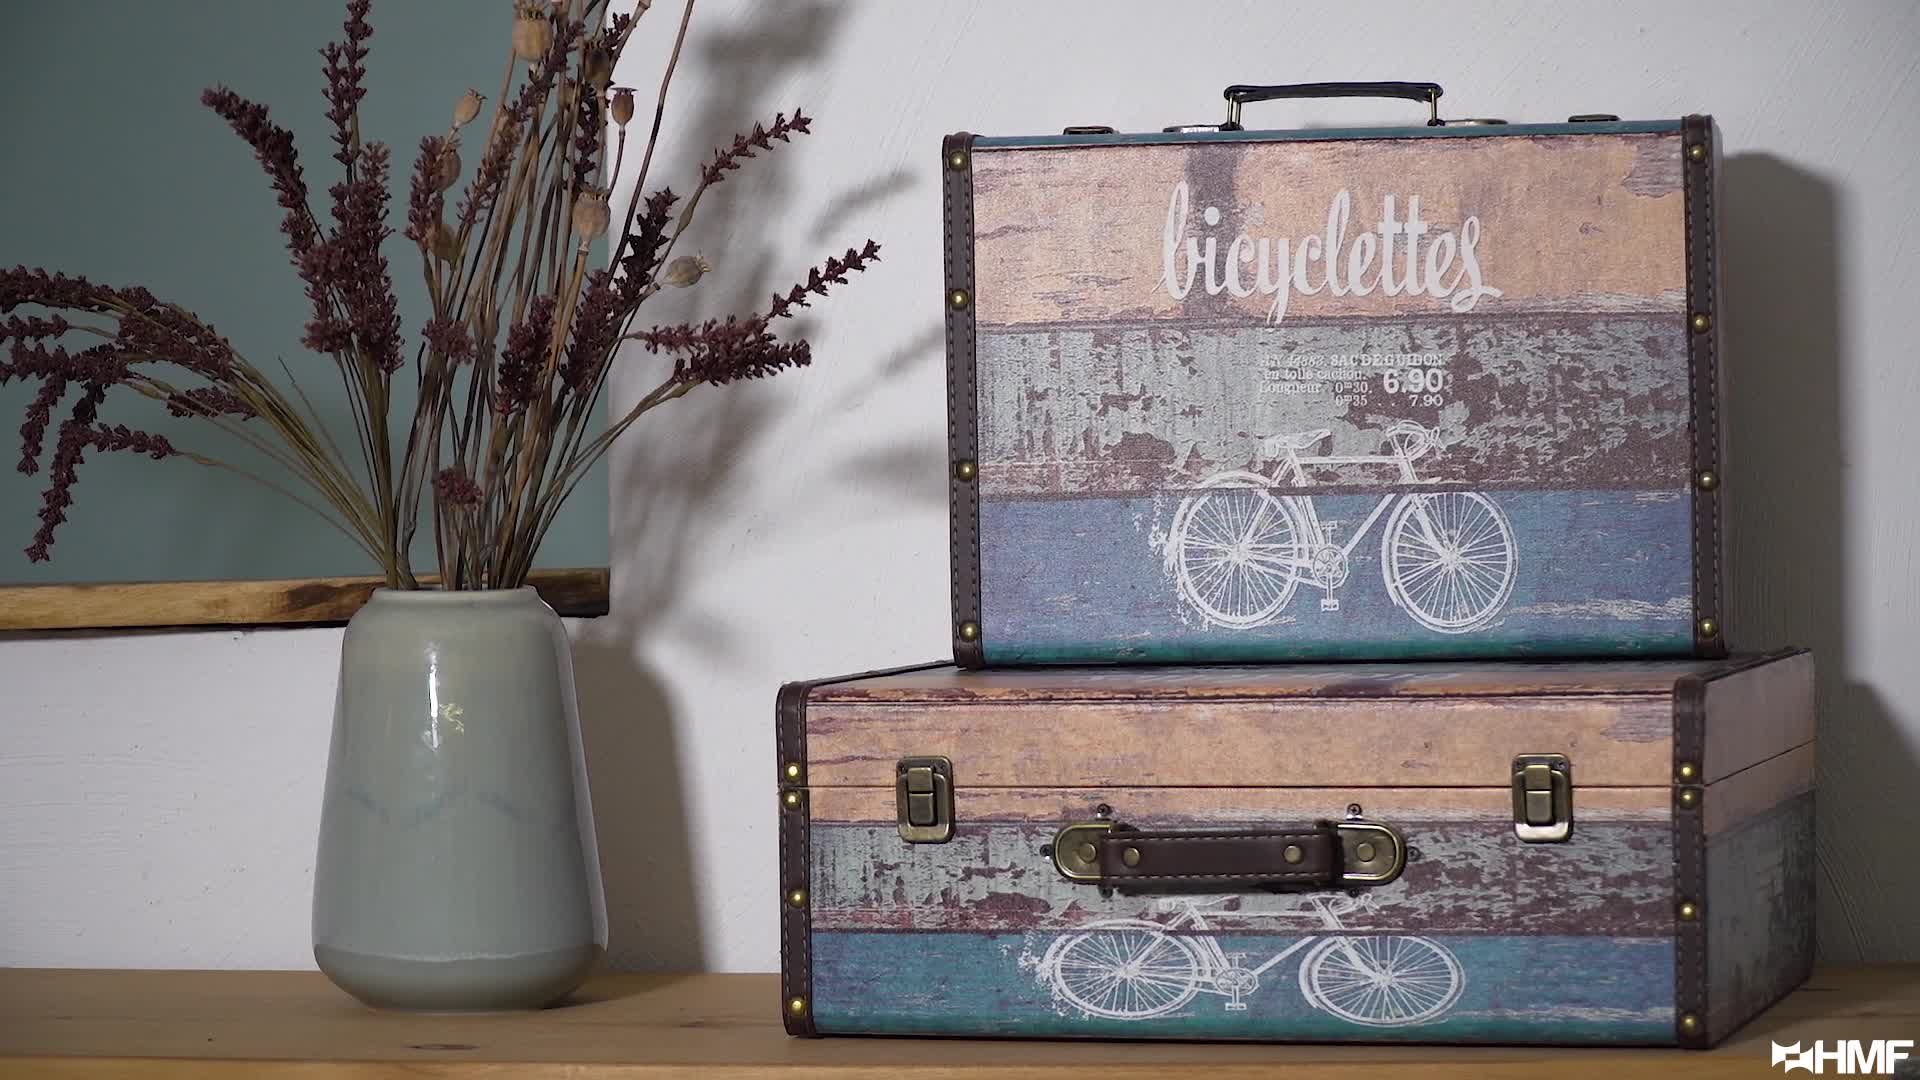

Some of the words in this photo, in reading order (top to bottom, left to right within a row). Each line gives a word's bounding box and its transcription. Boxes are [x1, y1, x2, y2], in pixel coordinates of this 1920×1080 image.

[1151, 180, 1502, 325] bicyclettes
[1382, 367, 1444, 394] 6.90
[1408, 393, 1444, 407] 7.90
